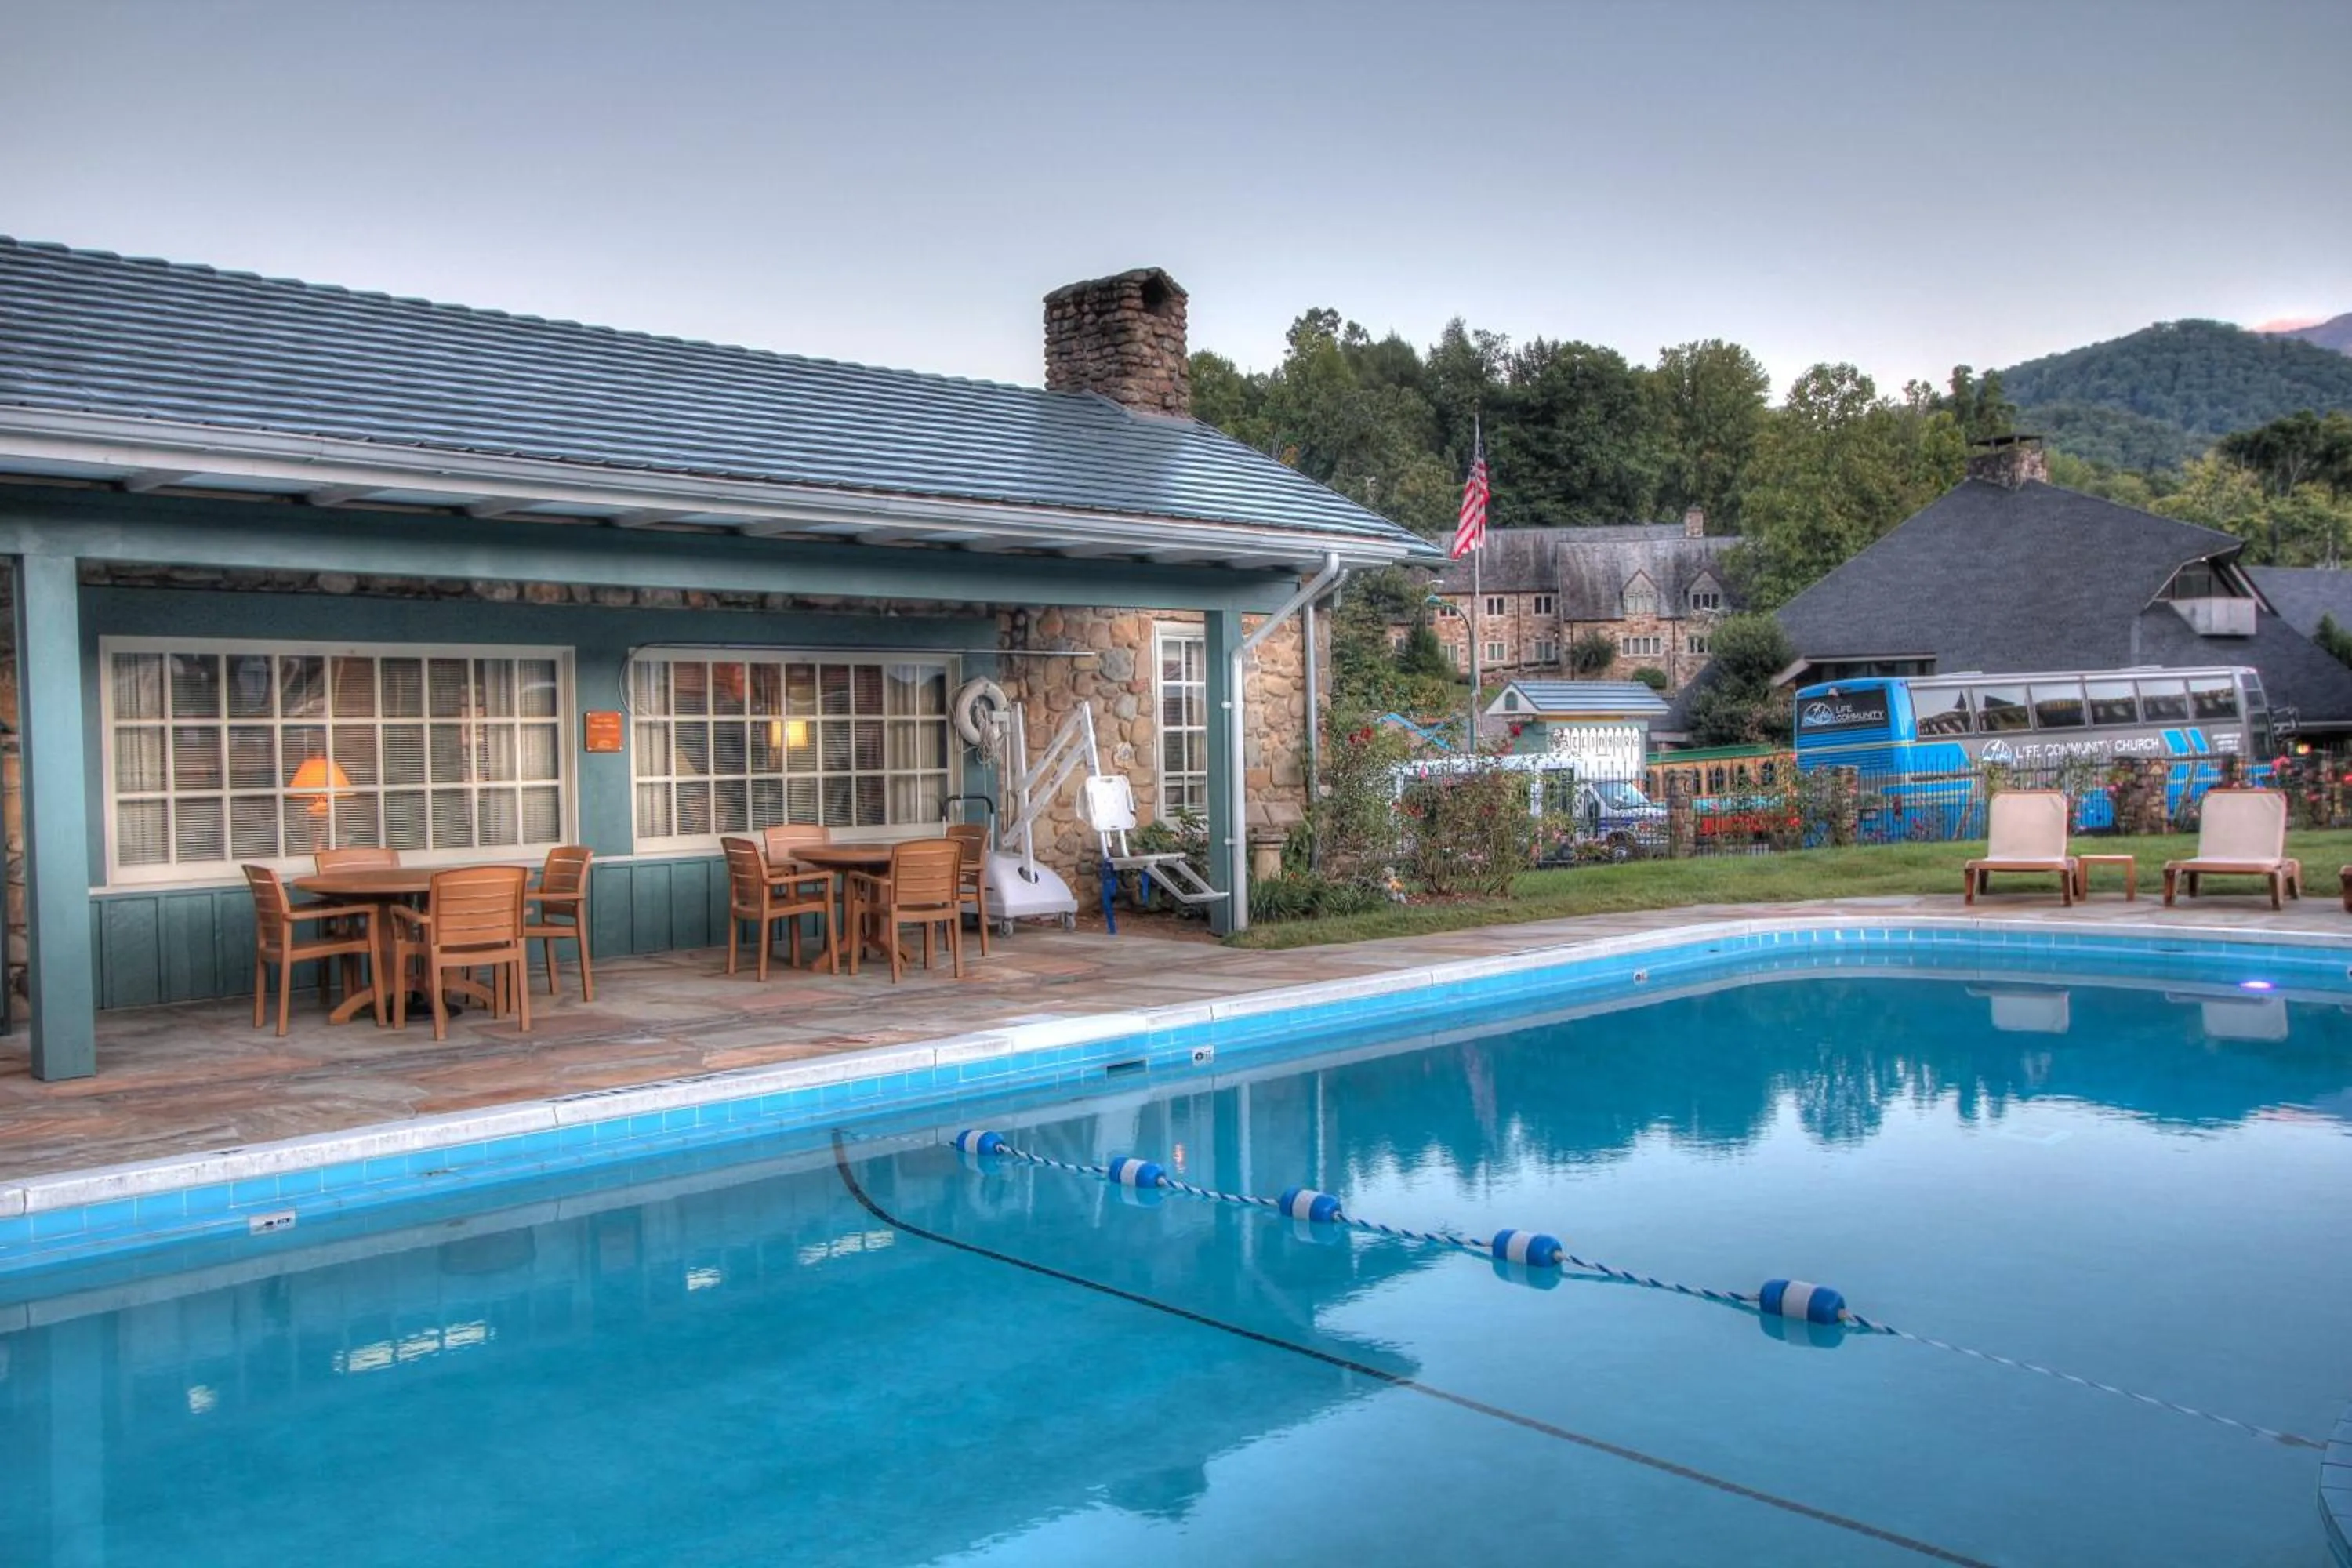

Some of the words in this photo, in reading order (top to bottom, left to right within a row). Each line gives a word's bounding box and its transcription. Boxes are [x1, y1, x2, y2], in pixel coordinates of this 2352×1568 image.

[1835, 705, 1853, 714] LIFE
[1836, 710, 1885, 723] COMMUNITY
[1553, 735, 1640, 749] ATLINBURG
[2044, 740, 2112, 757] COMMUNITY
[2114, 738, 2159, 752] CHURCH
